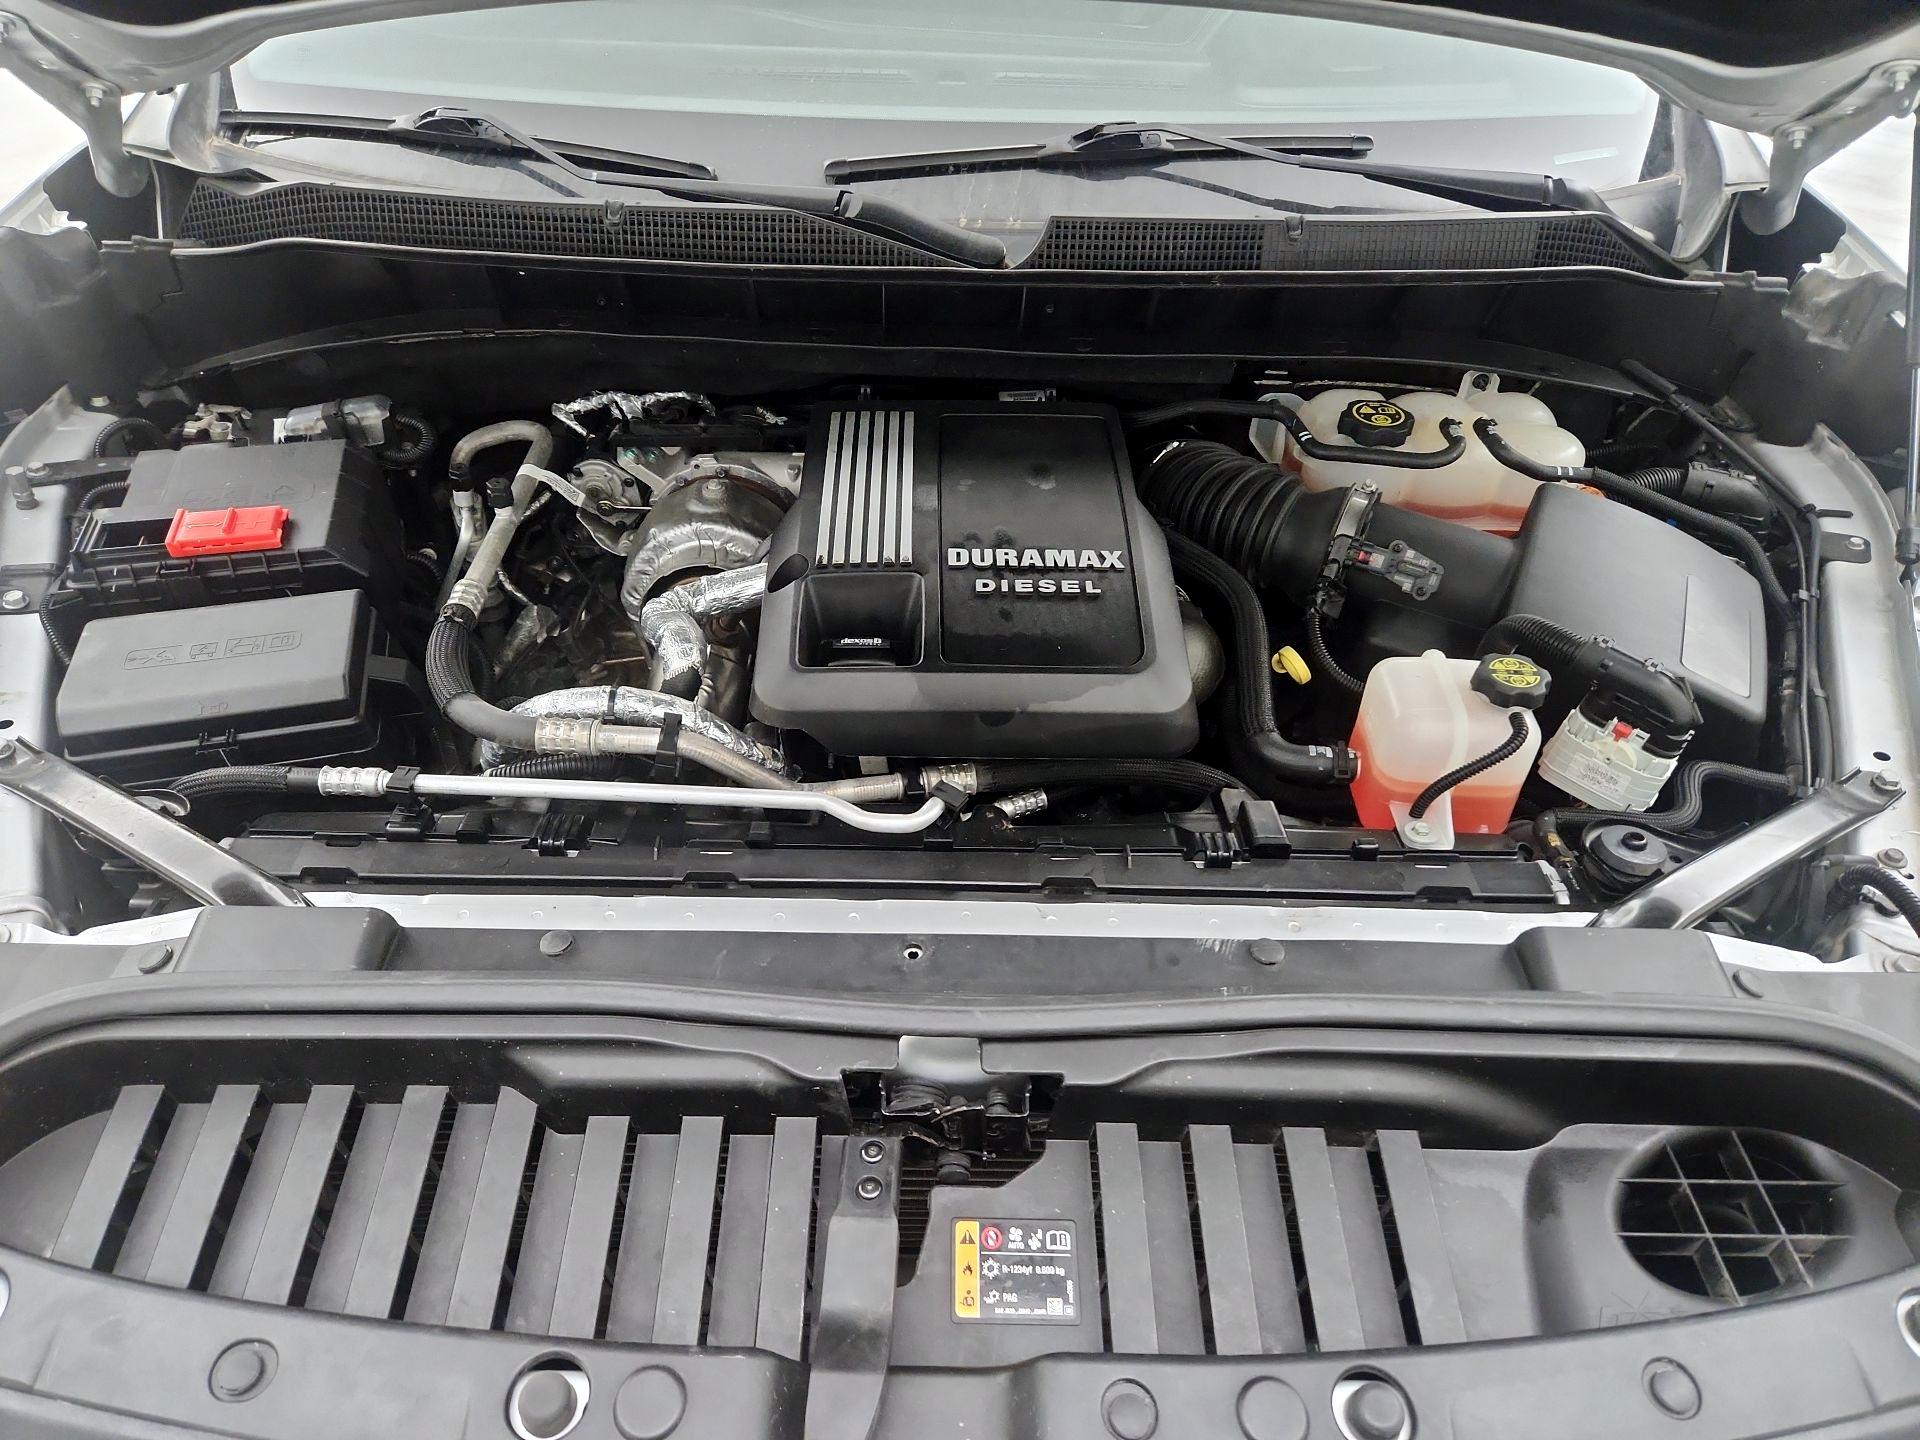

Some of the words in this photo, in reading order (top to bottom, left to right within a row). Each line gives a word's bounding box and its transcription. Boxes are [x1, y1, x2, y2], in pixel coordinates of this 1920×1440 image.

[947, 547, 1125, 570] DURAMAX
[974, 578, 1102, 595] DIESEL
[1007, 1241, 1025, 1250] AUTO
[1002, 1292, 1019, 1303] PAG
